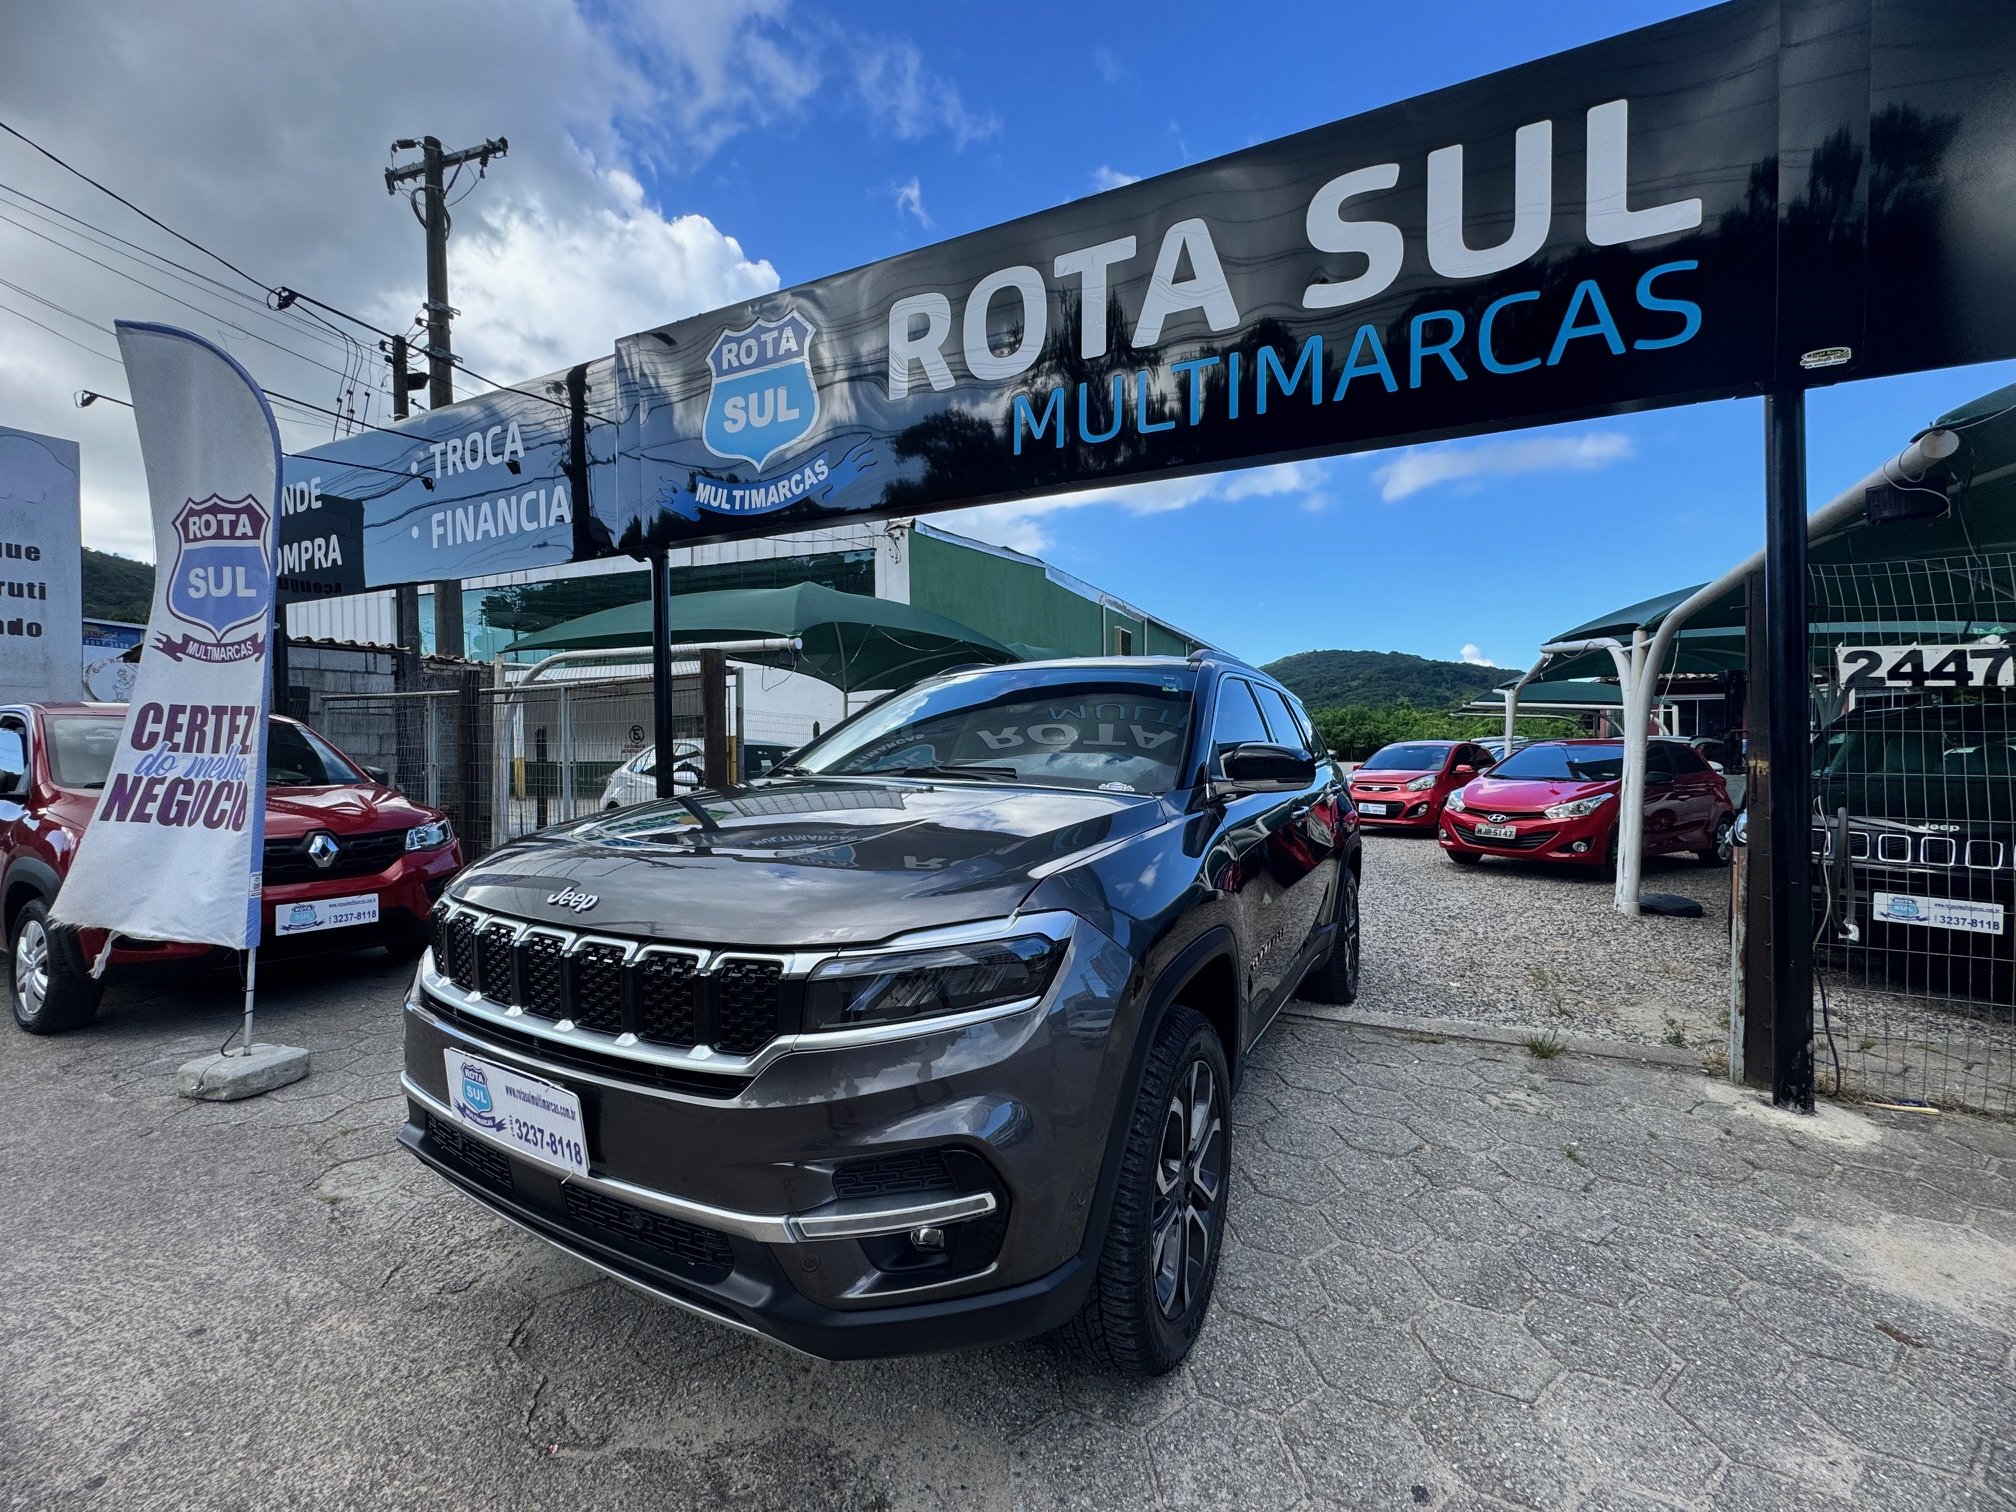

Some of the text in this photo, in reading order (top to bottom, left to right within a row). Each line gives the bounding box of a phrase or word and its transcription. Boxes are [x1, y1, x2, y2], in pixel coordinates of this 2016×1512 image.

[889, 98, 1702, 401] ROTA SUL
[721, 326, 799, 370] ROTA
[1012, 258, 1702, 457] MULTIMARCAS
[723, 385, 800, 434] SUL
[429, 421, 525, 479] TROCA
[695, 458, 829, 511] MULTIMARCAS
[188, 513, 254, 540] ROTA
[431, 485, 572, 549] FINANCIA
[0, 541, 41, 562] ue
[188, 565, 257, 599] SUL
[186, 640, 254, 662] MULTIMARCAS
[1842, 648, 2012, 687] 2447
[130, 701, 259, 755] CERTEZ
[133, 741, 179, 777] do
[1918, 822, 1960, 832] Jeep
[333, 910, 377, 924] 3237-8118
[547, 886, 599, 913] Jeep
[1939, 915, 2000, 931] 3237-8118
[464, 1067, 484, 1084] ROTA
[466, 1085, 487, 1103] SUL
[514, 1118, 583, 1166] 3237-8118
